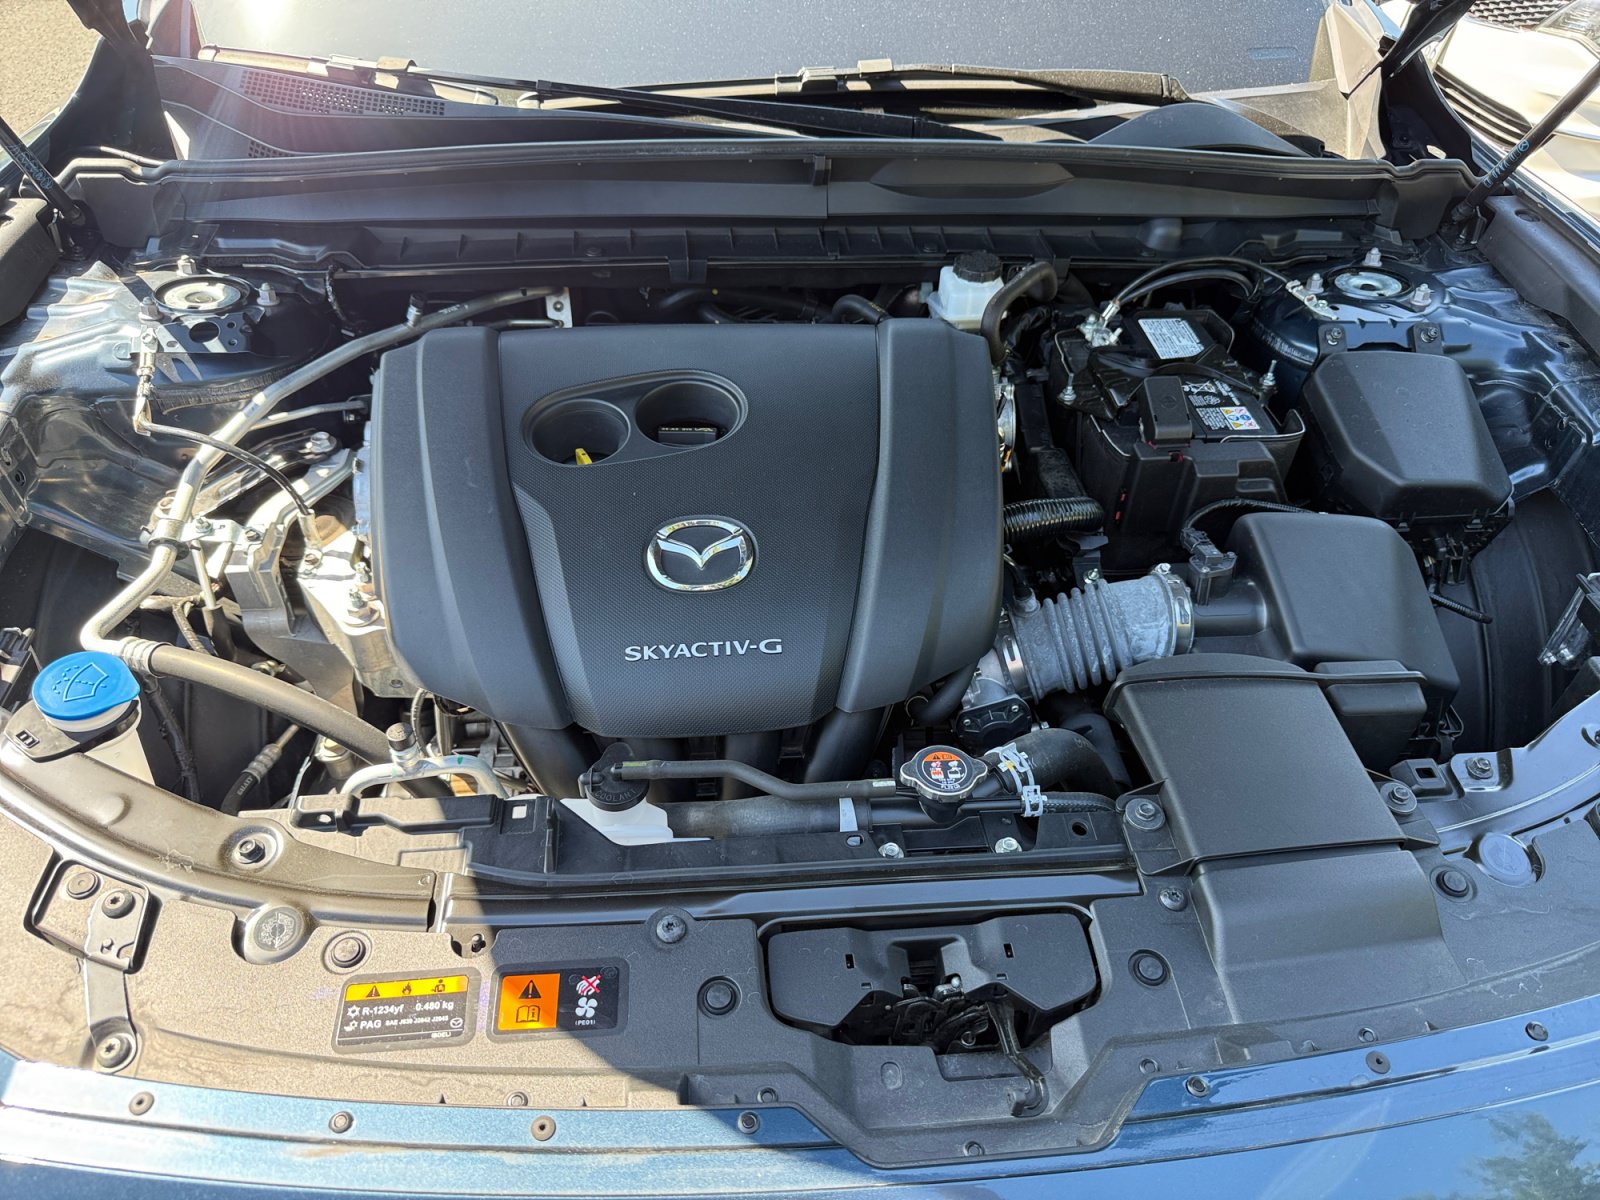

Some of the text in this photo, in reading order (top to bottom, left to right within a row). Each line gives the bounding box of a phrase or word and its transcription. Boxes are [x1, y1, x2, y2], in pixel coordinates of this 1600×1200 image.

[625, 638, 783, 662] SKYACTIV-G
[594, 788, 636, 801] COOLANT
[361, 1000, 454, 1016] R-1234yf 0.480 kg
[360, 1019, 382, 1030] PAG
